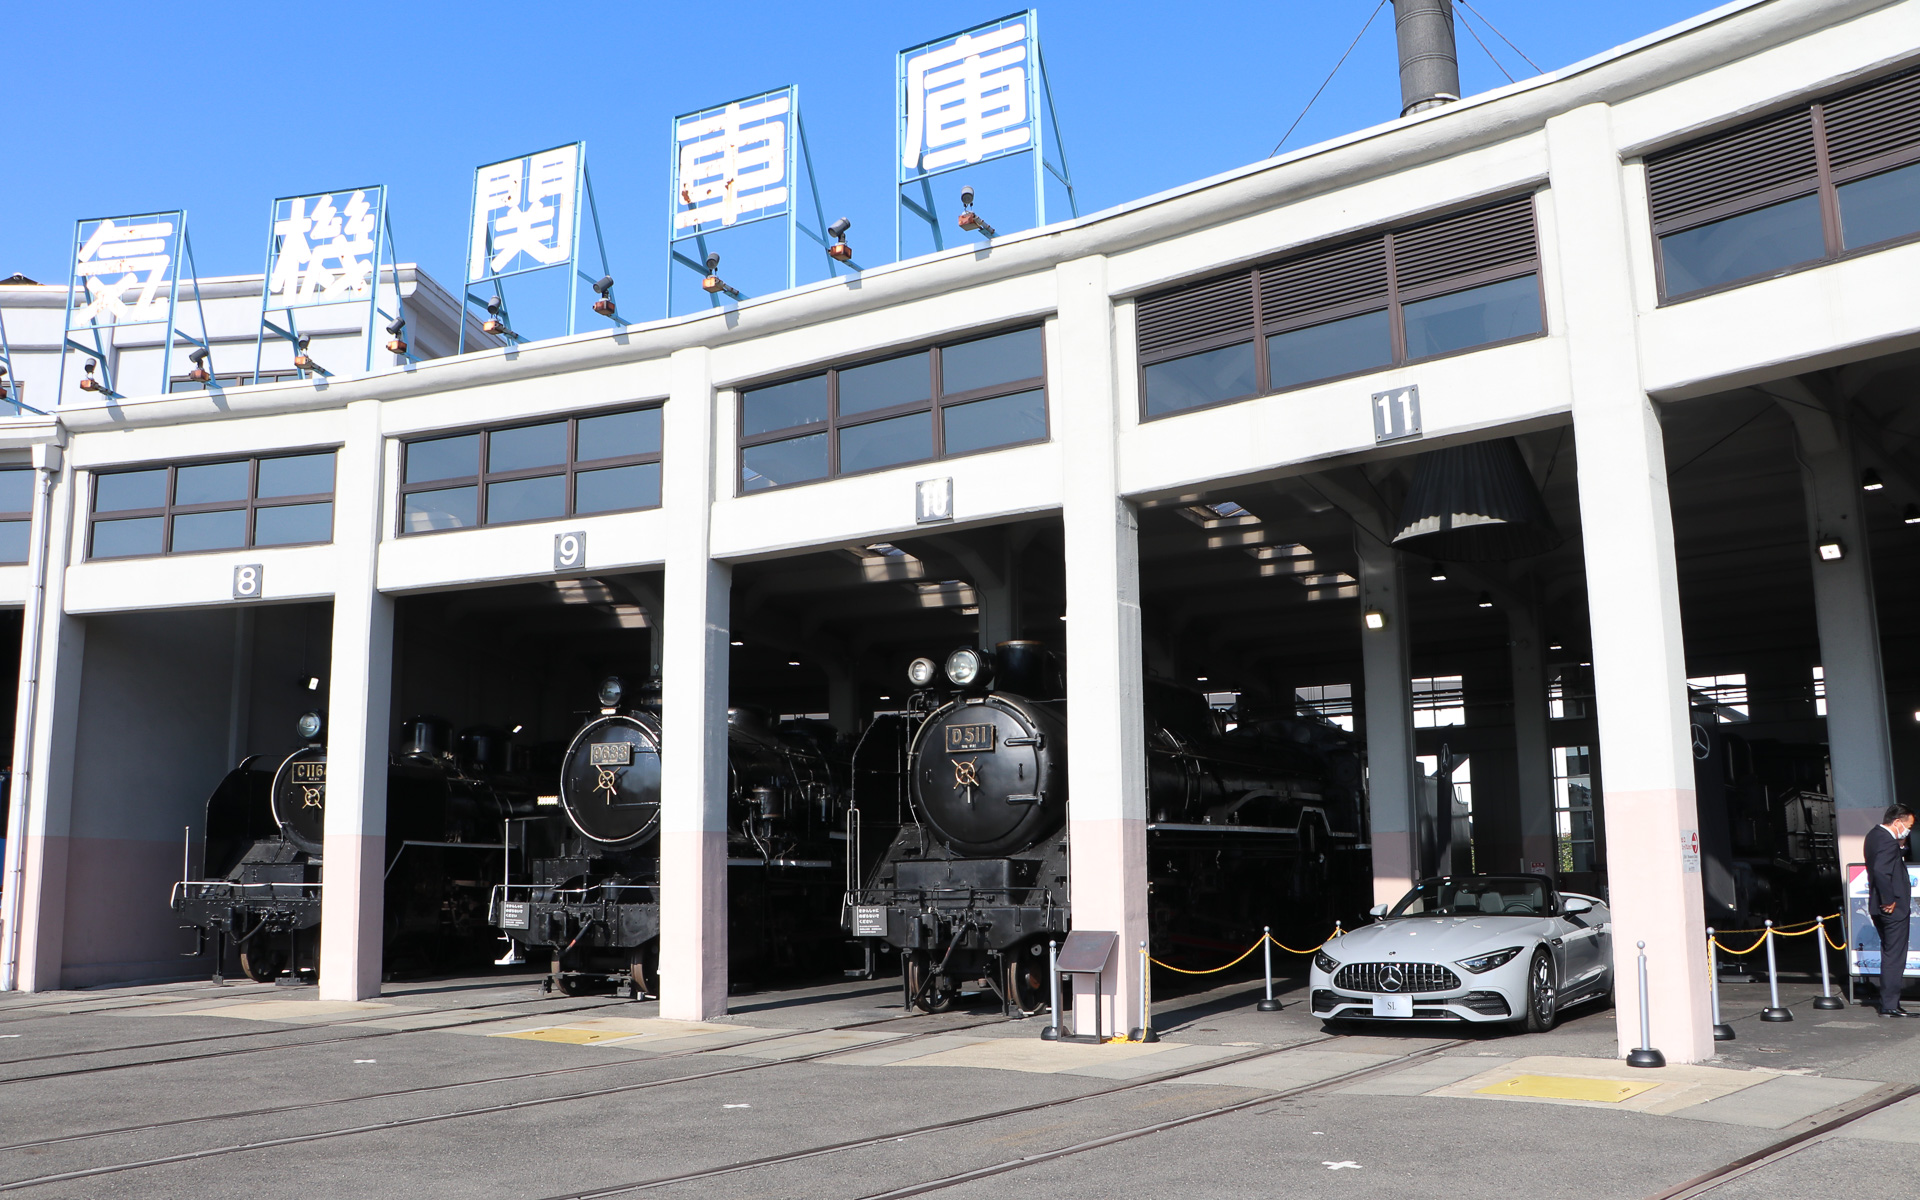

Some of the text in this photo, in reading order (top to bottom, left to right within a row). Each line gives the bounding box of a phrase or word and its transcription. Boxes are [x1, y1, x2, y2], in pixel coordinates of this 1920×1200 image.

[1377, 390, 1413, 435] 11
[920, 480, 948, 518] 10
[559, 535, 579, 566] 9
[237, 566, 256, 595] 8
[297, 764, 326, 778] C116
[1387, 1001, 1397, 1010] SL
